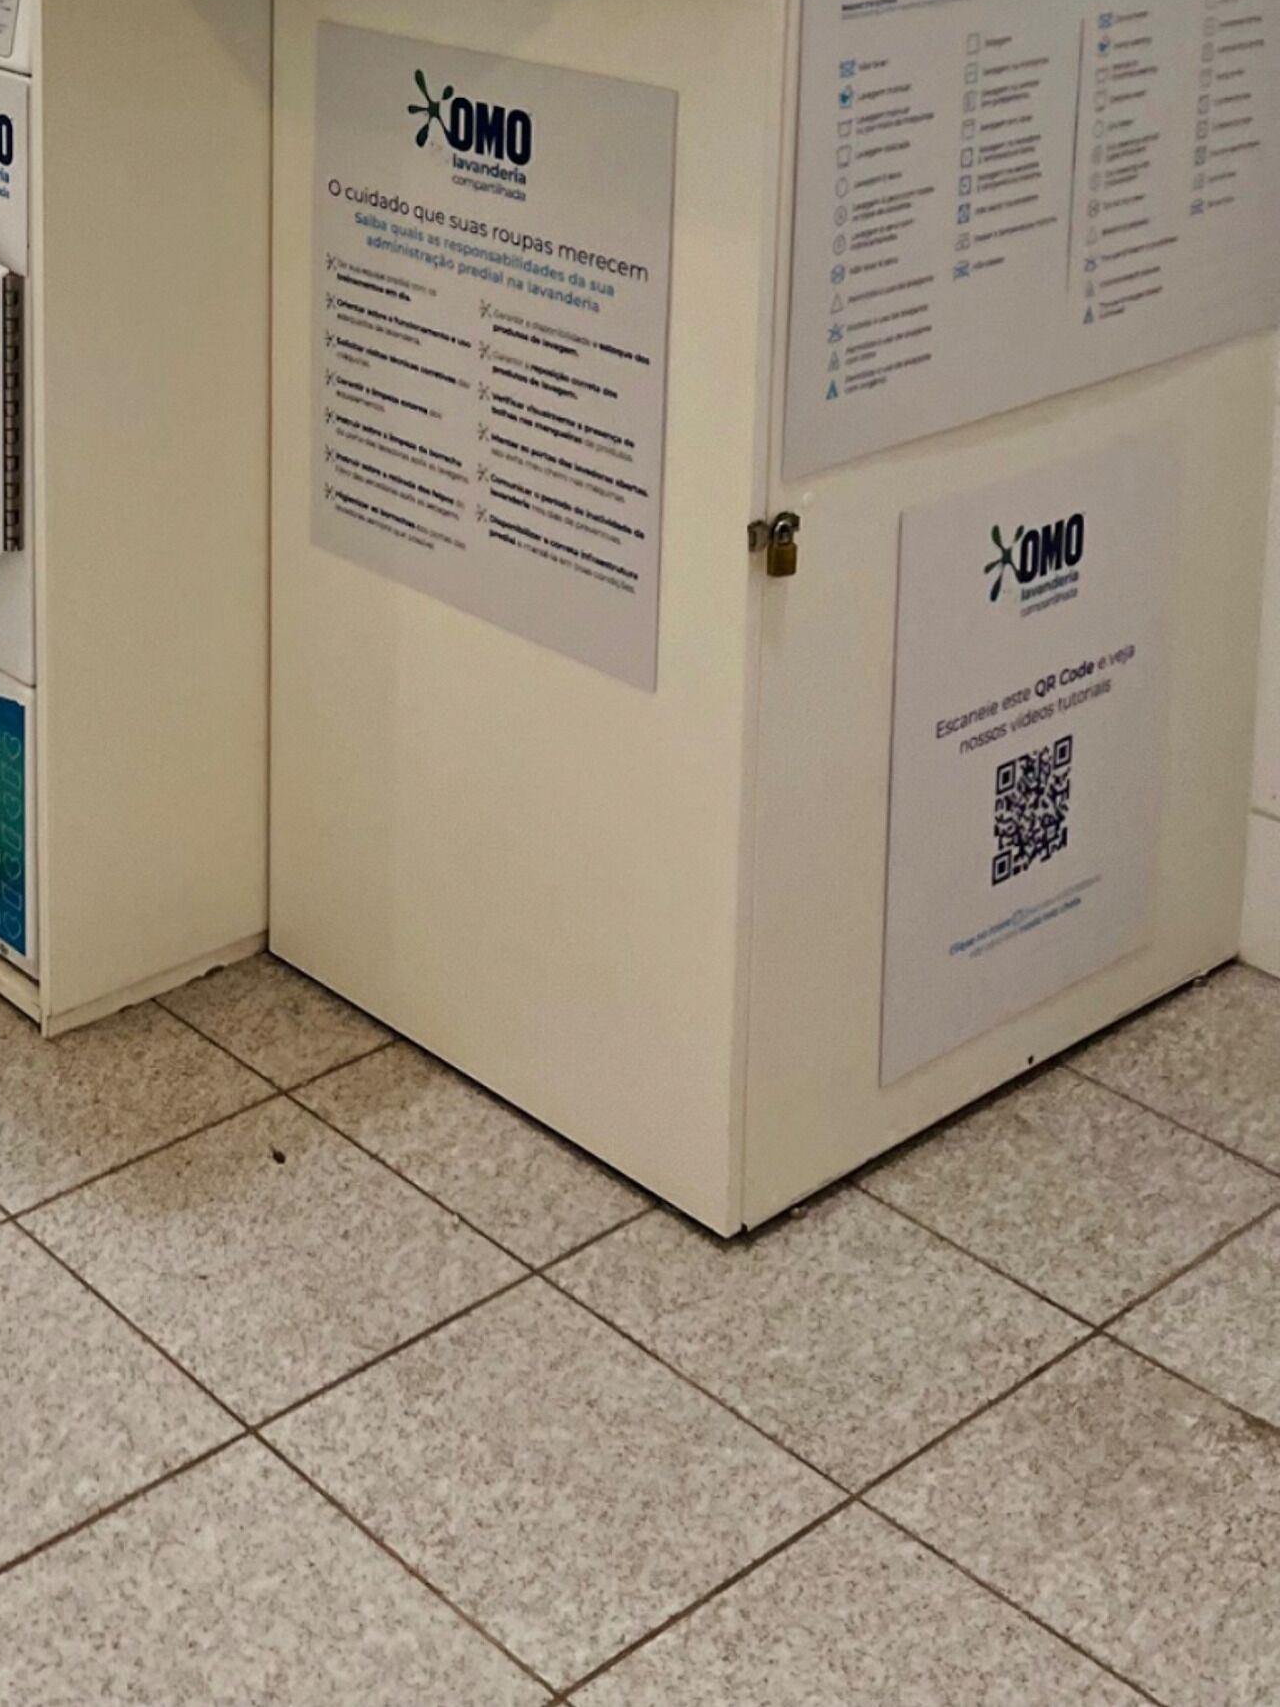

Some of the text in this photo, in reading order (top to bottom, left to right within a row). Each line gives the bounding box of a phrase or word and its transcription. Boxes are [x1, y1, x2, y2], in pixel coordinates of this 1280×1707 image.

[449, 97, 532, 166] OMO
[452, 153, 526, 185] lavanderia
[327, 179, 650, 283] O cuidado que suas roupas merecem
[355, 212, 387, 232] Saiba
[391, 223, 424, 243] quais
[427, 233, 441, 246] as
[443, 235, 565, 283] responsabilidades
[568, 271, 586, 288] da
[589, 278, 615, 297] sua
[366, 235, 455, 270] administração
[457, 260, 504, 284] predial
[507, 276, 524, 291] na
[527, 280, 600, 313] lavanderia
[1019, 513, 1085, 584] OMO
[1020, 570, 1079, 602] lavanderia
[936, 644, 1136, 739] Escaneie este QR Code e veja
[959, 678, 1112, 755] nossos vídeos tutoriais
